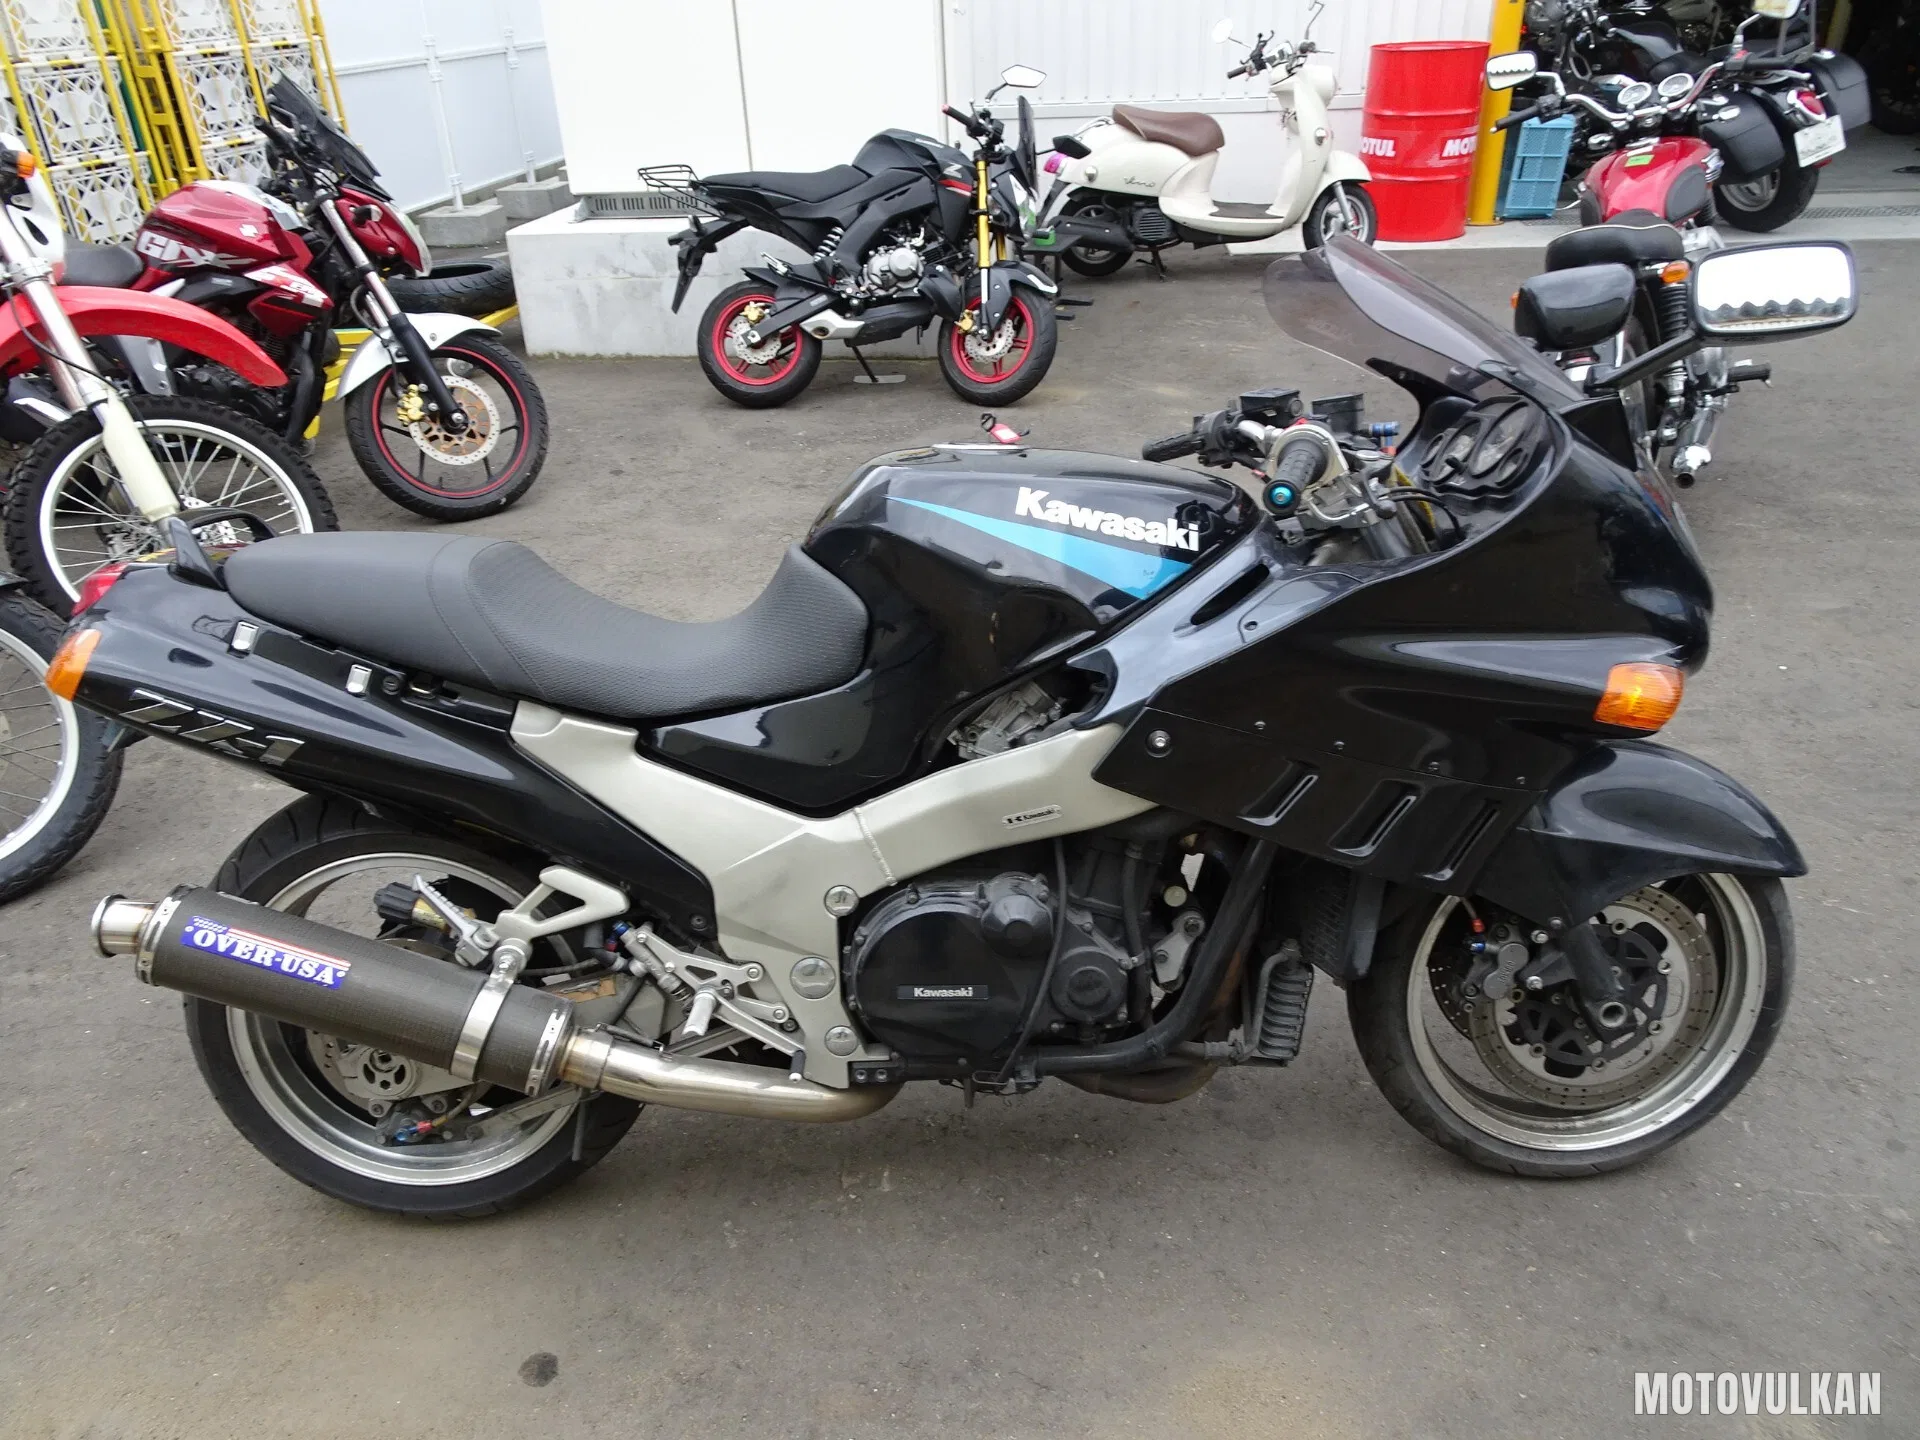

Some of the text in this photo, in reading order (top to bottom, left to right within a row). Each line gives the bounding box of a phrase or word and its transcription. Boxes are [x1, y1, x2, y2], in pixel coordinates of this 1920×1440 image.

[1360, 136, 1396, 157] OTUL
[1015, 487, 1199, 551] Kawasaki
[193, 929, 335, 985] OVER-USA
[913, 987, 973, 997] Kawasaki
